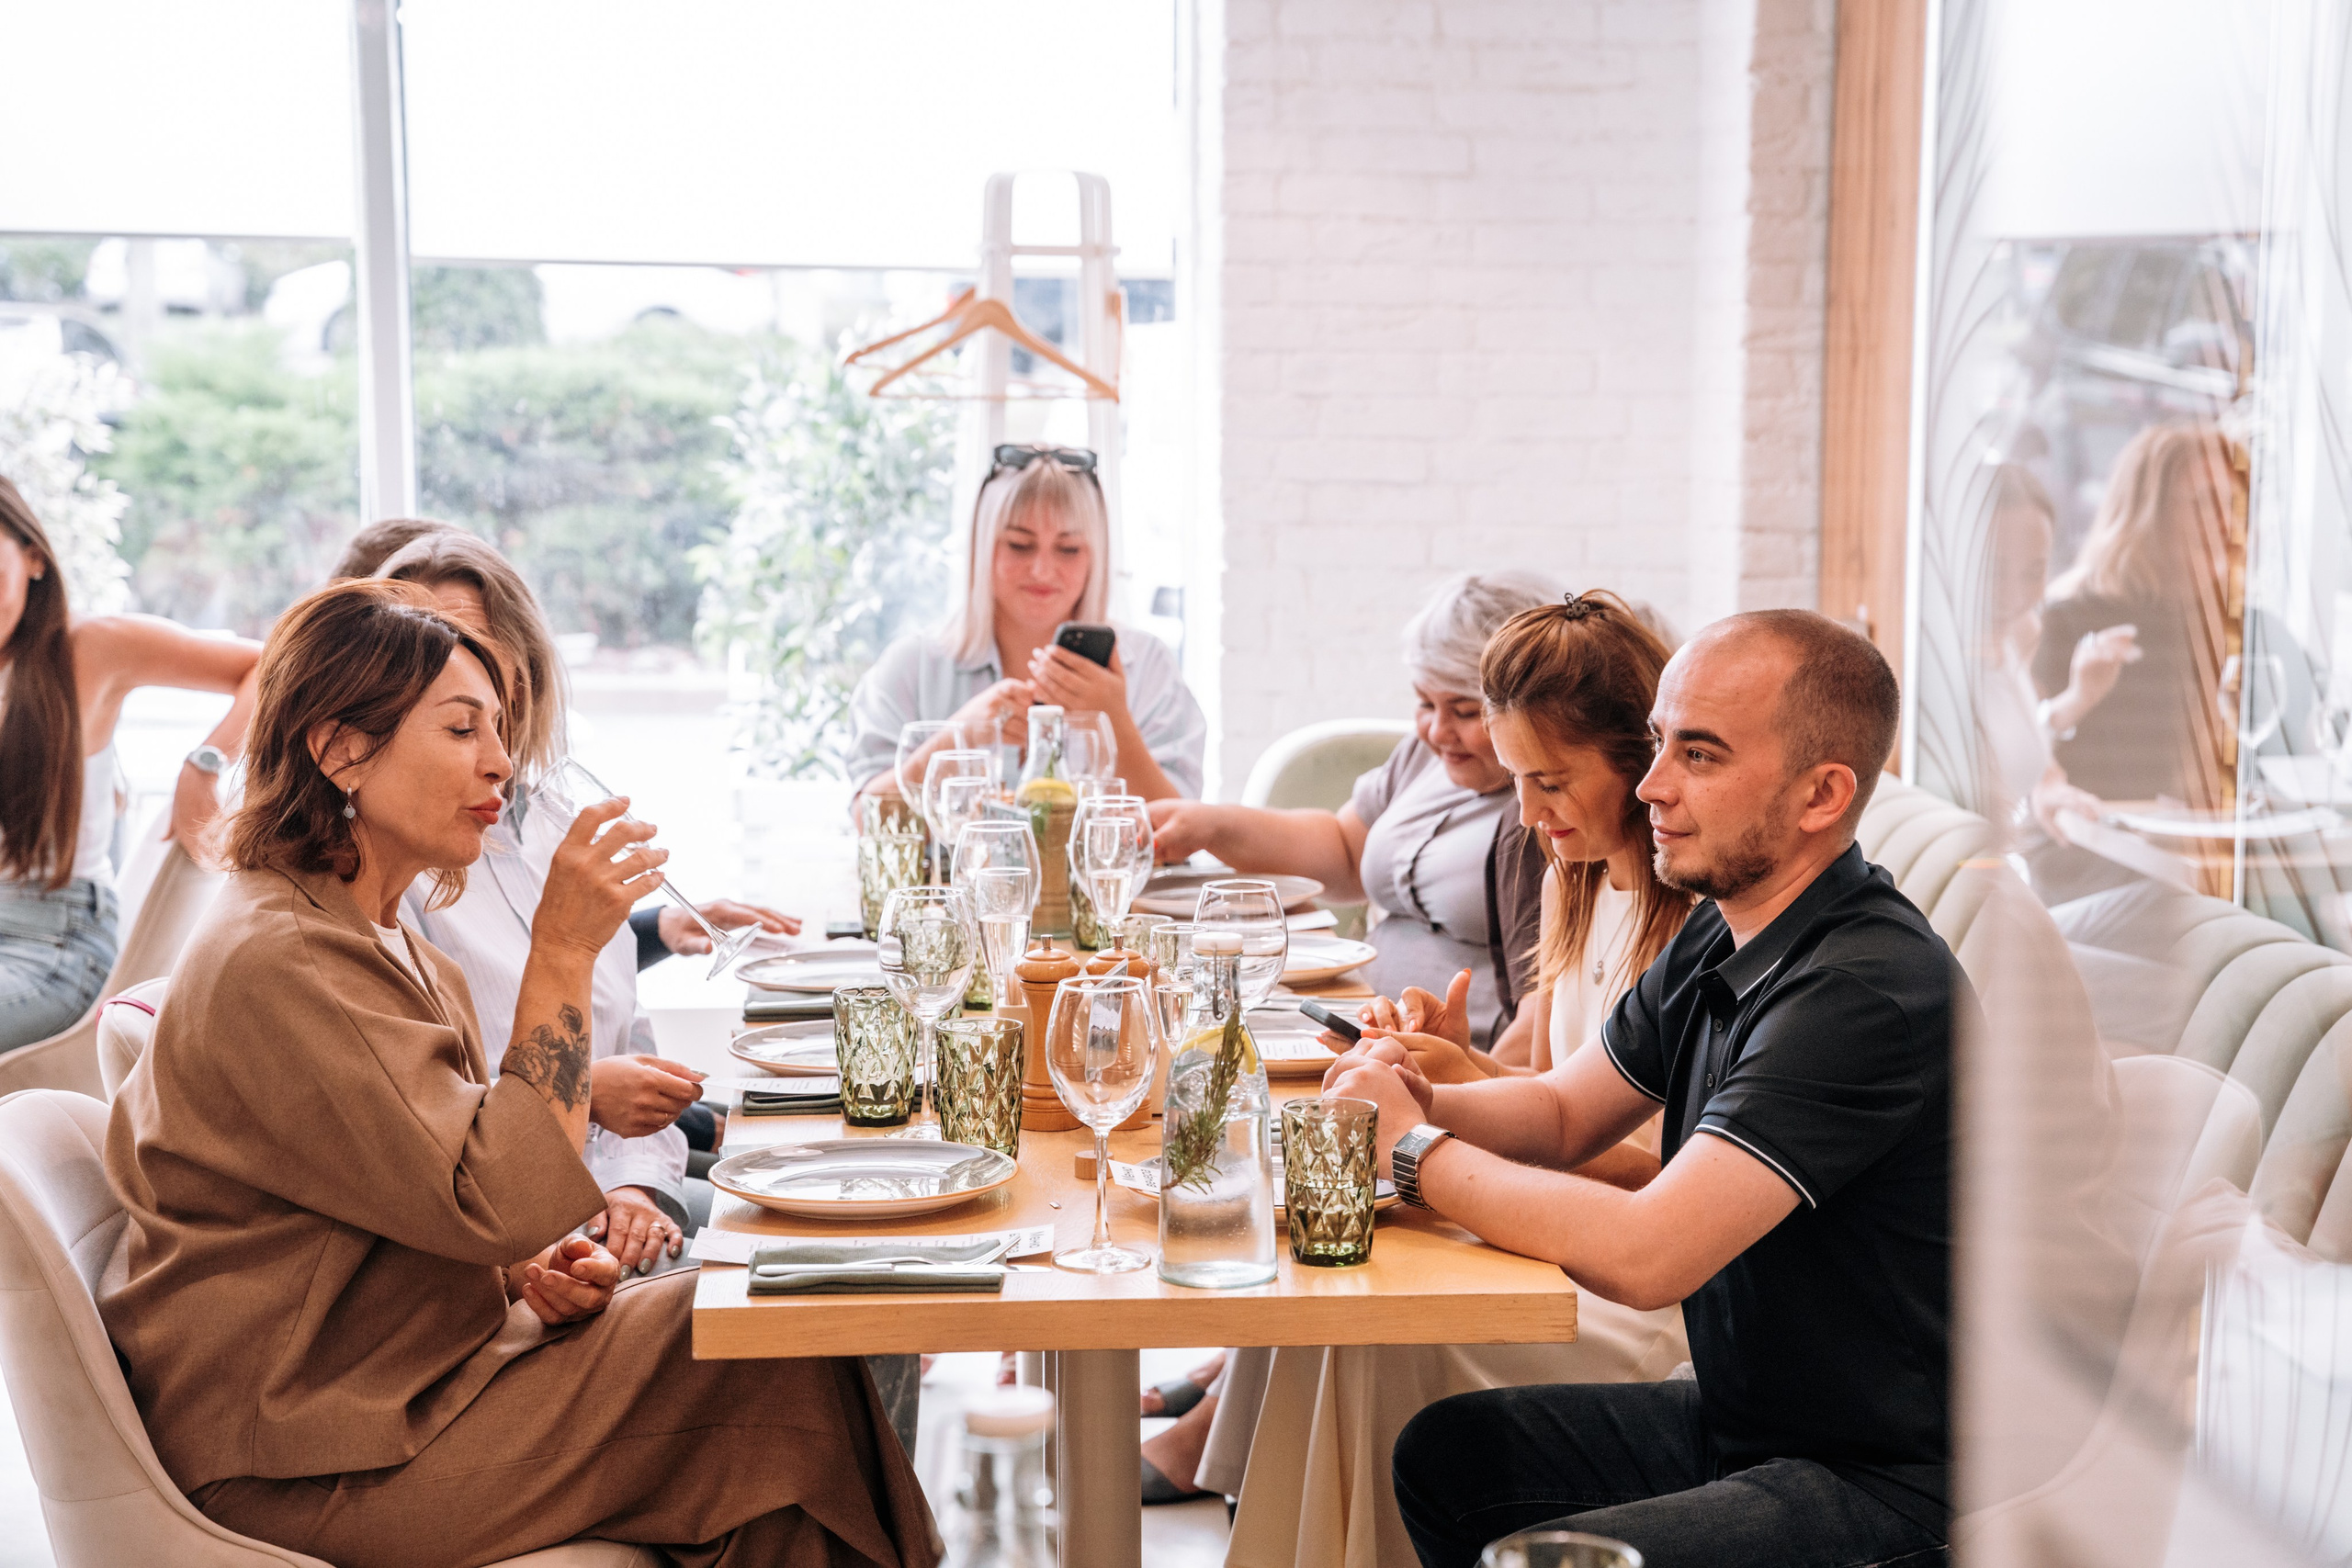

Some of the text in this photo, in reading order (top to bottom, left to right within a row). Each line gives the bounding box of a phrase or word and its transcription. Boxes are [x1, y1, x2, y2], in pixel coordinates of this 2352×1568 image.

[1122, 1166, 1136, 1182] Меню
[1140, 1168, 1158, 1188] вечера
[1029, 1231, 1044, 1248] Меню
